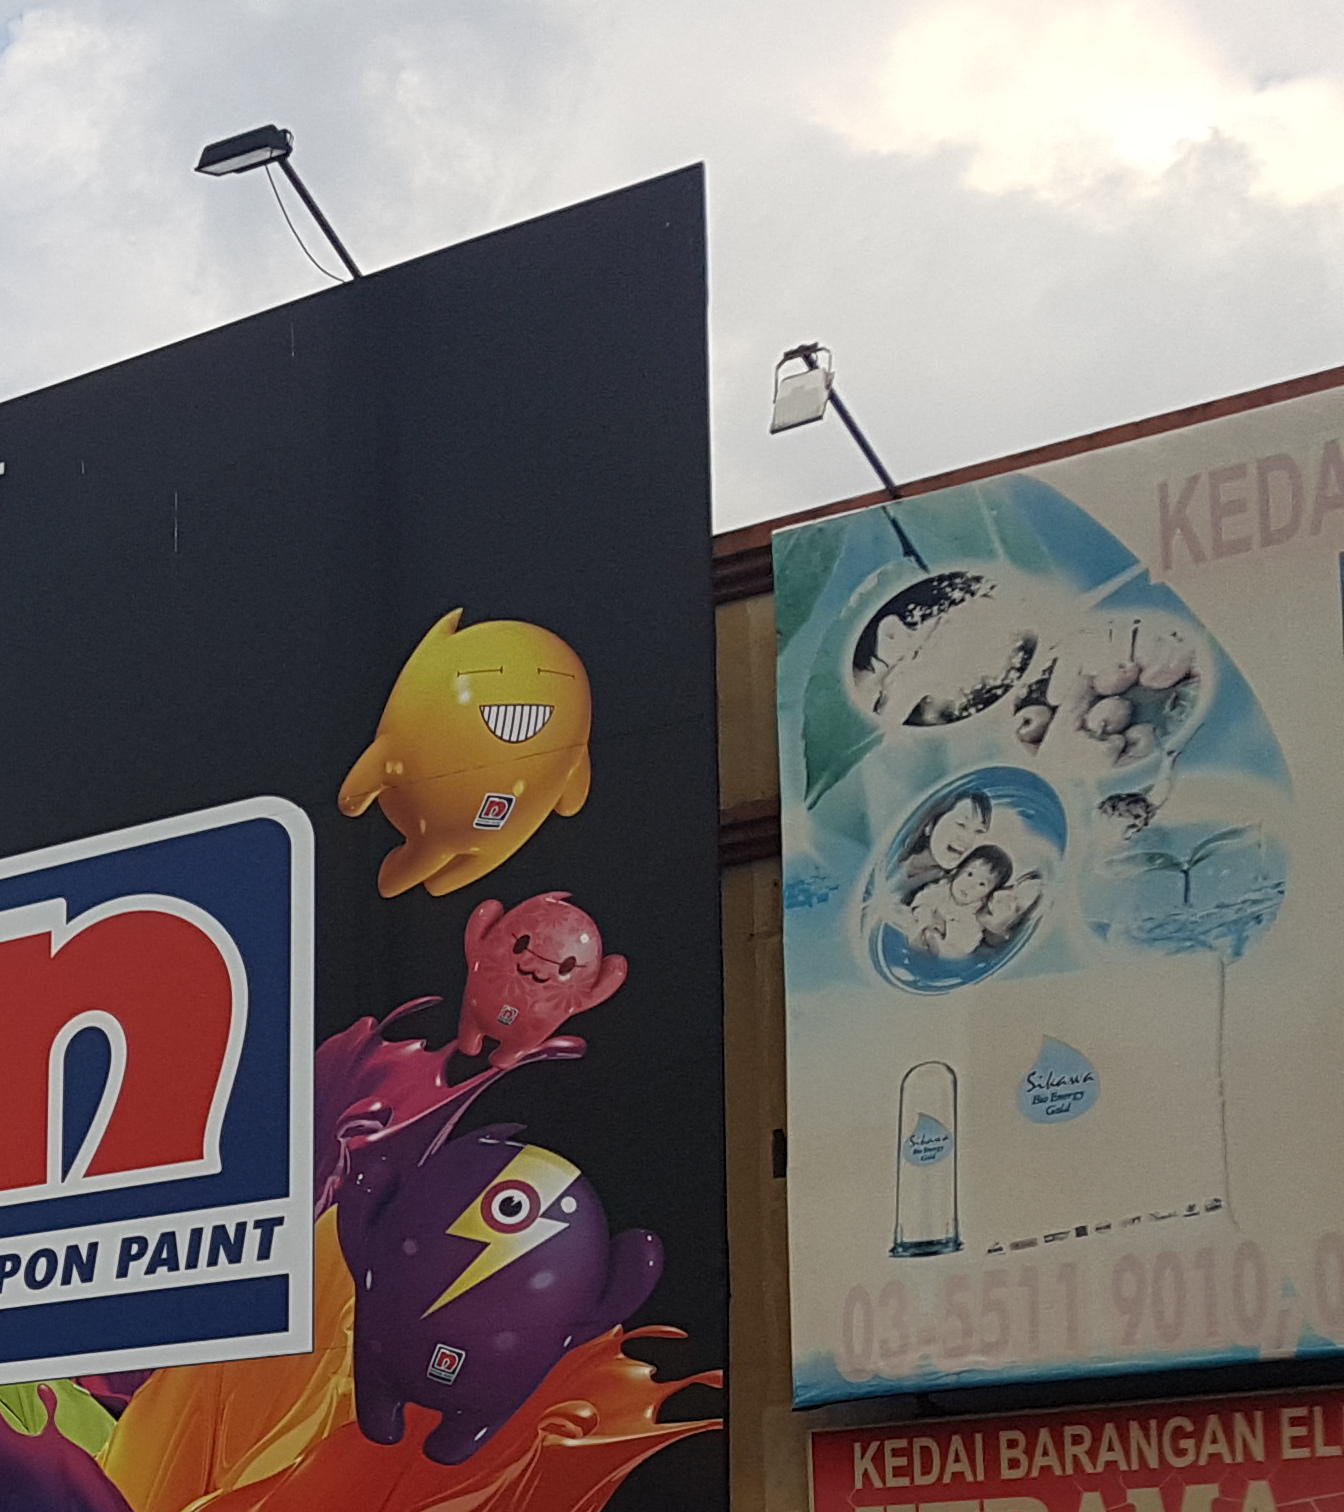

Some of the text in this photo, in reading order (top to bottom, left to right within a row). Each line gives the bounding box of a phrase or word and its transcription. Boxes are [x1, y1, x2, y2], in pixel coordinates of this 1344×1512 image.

[113, 1214, 285, 1280] PAINT
[852, 1410, 1264, 1489] KEDAI BARANGAN
